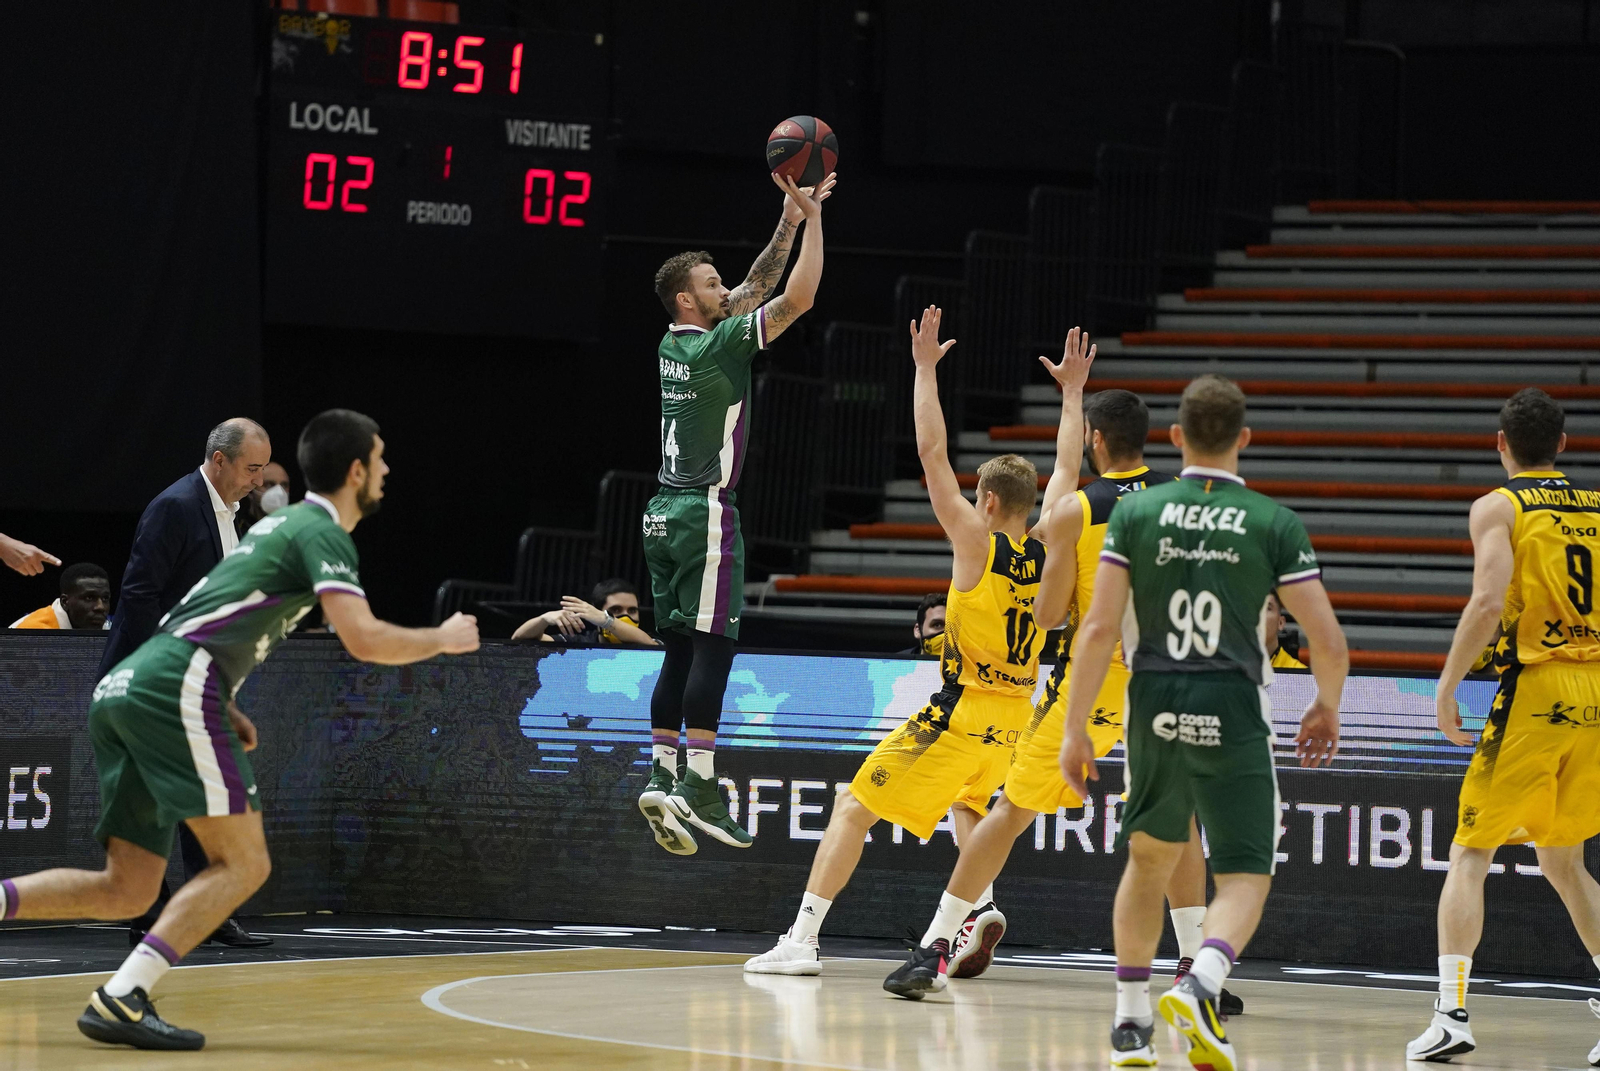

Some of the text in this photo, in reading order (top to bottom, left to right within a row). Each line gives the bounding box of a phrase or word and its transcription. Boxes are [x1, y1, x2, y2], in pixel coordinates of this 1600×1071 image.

[397, 31, 523, 94] 8:51
[290, 102, 378, 135] LOCAL
[505, 119, 591, 150] VISITANTE
[303, 153, 375, 213] 02
[443, 146, 452, 180] 1
[406, 201, 472, 226] PERIODO
[523, 169, 591, 227] 02
[660, 357, 690, 381] ADAMS
[1159, 502, 1247, 535] MEKEL
[1565, 543, 1593, 615] 9
[1002, 607, 1037, 667] 10
[1166, 588, 1222, 661] 99
[1178, 713, 1222, 727] COSTA
[0, 766, 52, 829] ES
